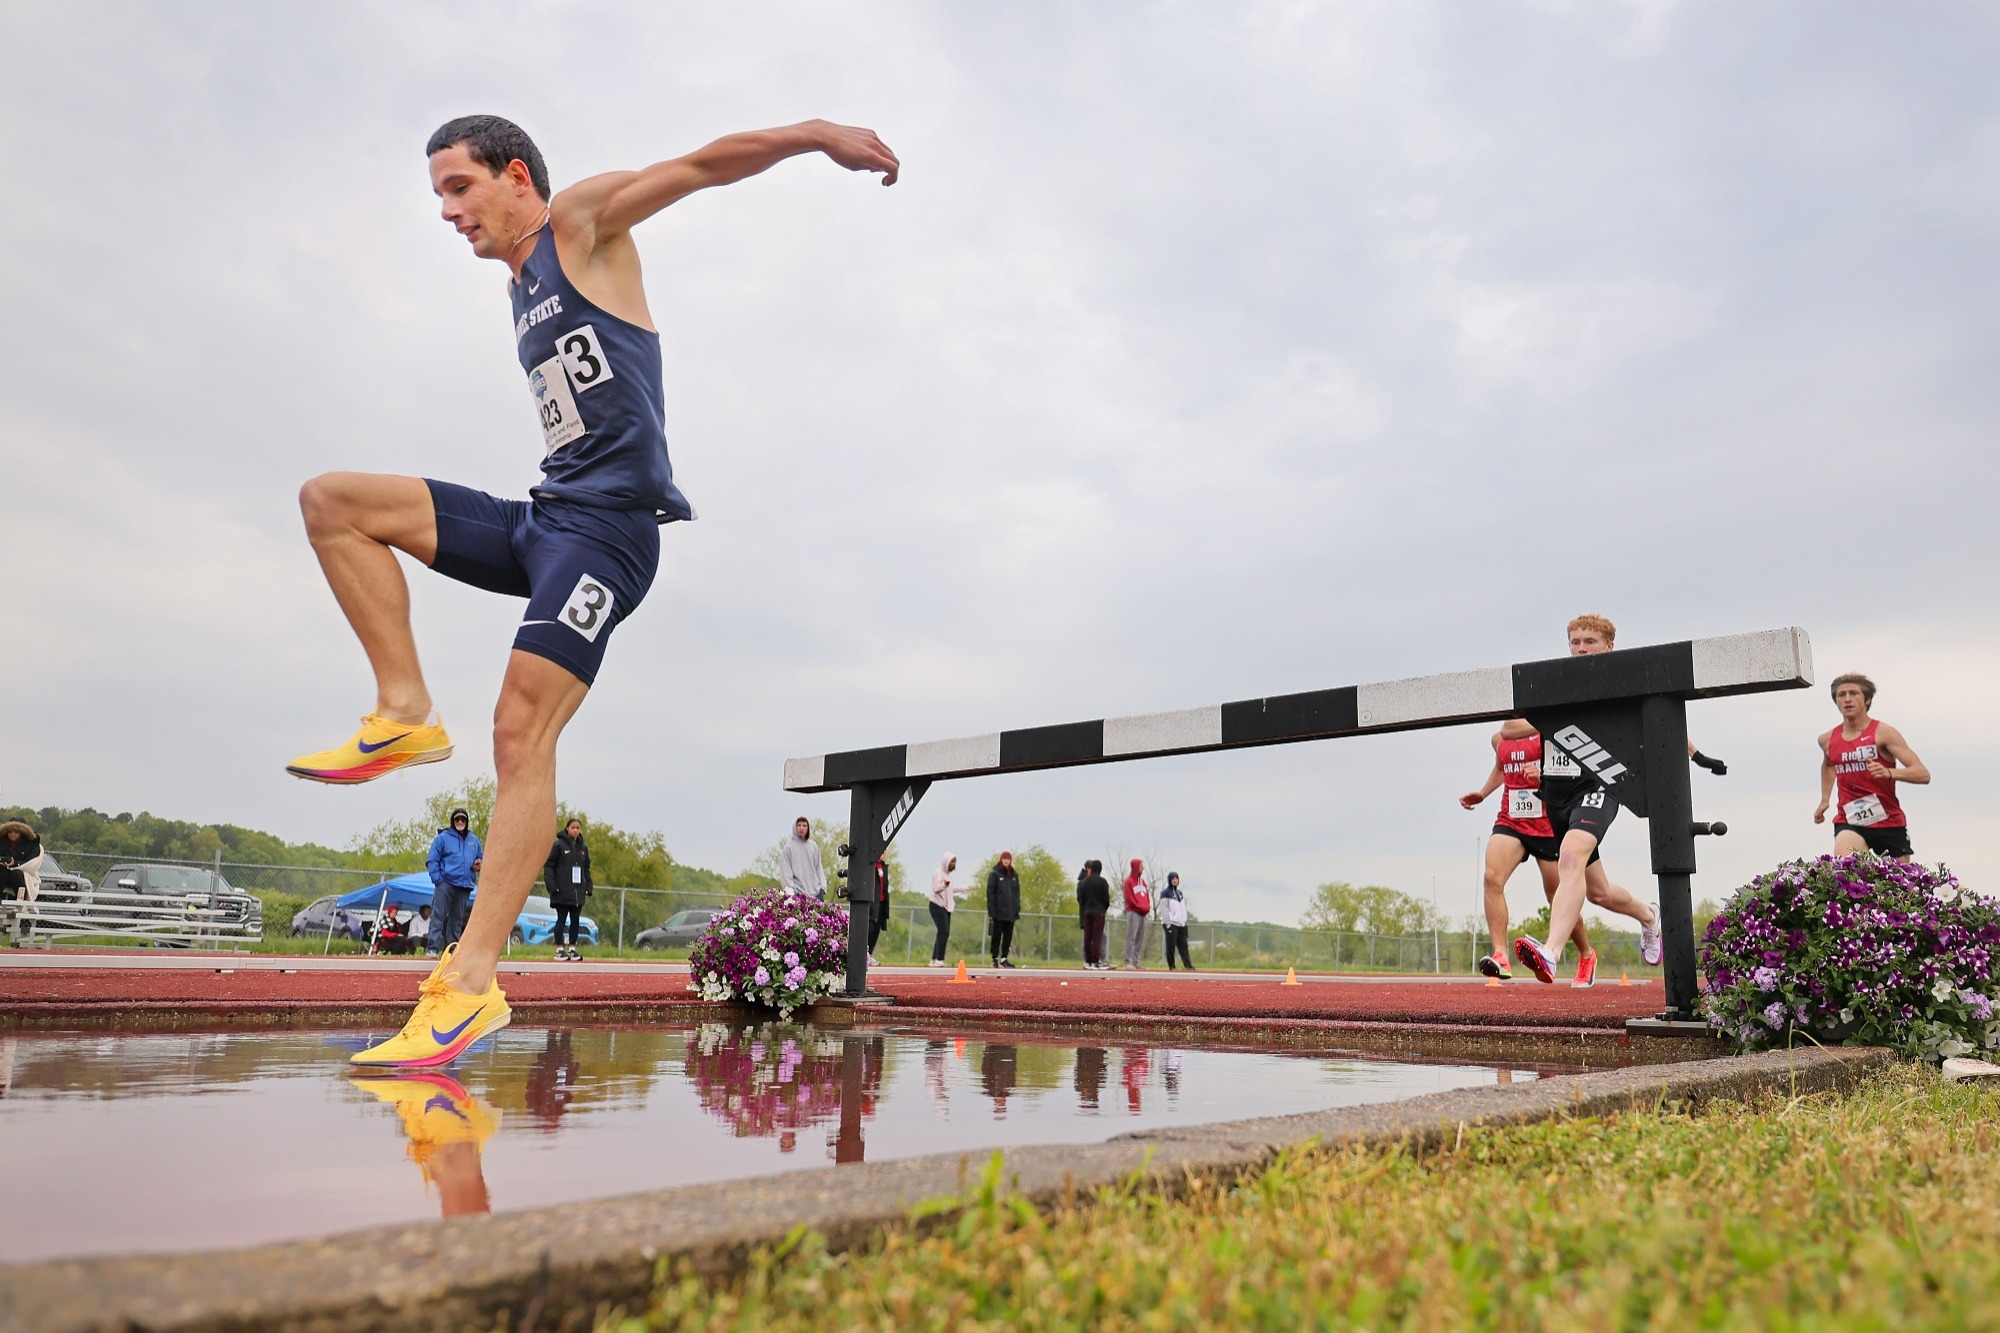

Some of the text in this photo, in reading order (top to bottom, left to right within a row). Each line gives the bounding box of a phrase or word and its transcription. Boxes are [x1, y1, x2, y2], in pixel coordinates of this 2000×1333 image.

[529, 294, 563, 327] STATE
[564, 334, 602, 384] 3
[568, 583, 607, 630] 3
[1510, 750, 1525, 761] RIO
[1553, 724, 1628, 786] GILL
[1841, 751, 1858, 762] RIO
[1858, 746, 1876, 760] 13
[1552, 755, 1570, 767] 148
[1503, 762, 1524, 774] GRA
[1834, 762, 1869, 774] GRAND
[1586, 792, 1602, 806] 8
[1515, 801, 1533, 811] 339
[881, 785, 914, 842] GILL
[1854, 808, 1874, 821] 321
